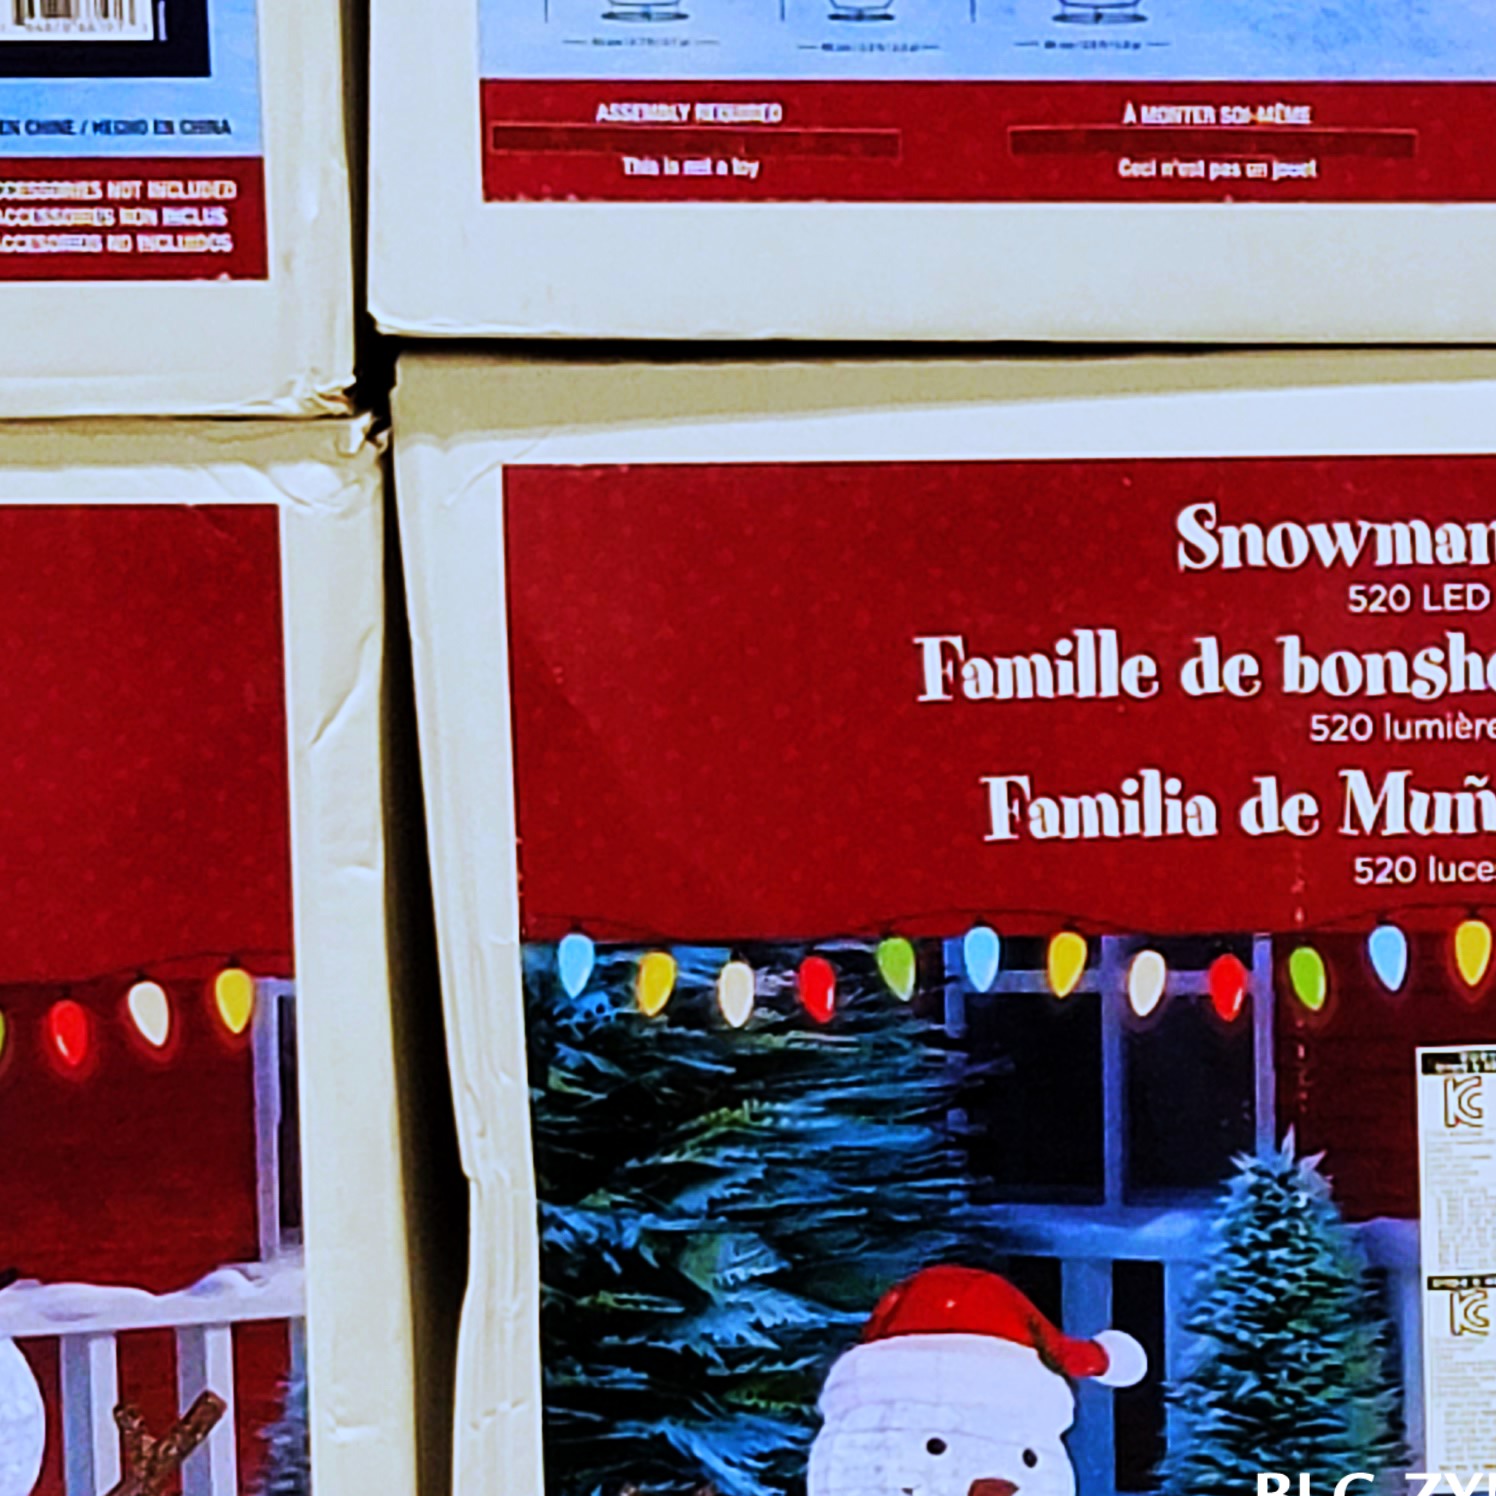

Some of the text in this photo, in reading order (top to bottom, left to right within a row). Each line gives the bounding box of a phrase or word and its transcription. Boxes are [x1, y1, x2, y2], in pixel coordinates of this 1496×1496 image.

[596, 103, 782, 122] ASSEMBLY REQUIRED
[623, 157, 759, 178] This is not a toy
[1348, 584, 1411, 614] 520
[1422, 584, 1491, 613] LED
[915, 629, 1160, 703] Famille
[1180, 637, 1261, 699] de
[1309, 713, 1374, 743] 520
[983, 769, 1218, 842] Familia
[1240, 775, 1319, 836] de
[1354, 856, 1417, 885] 520
